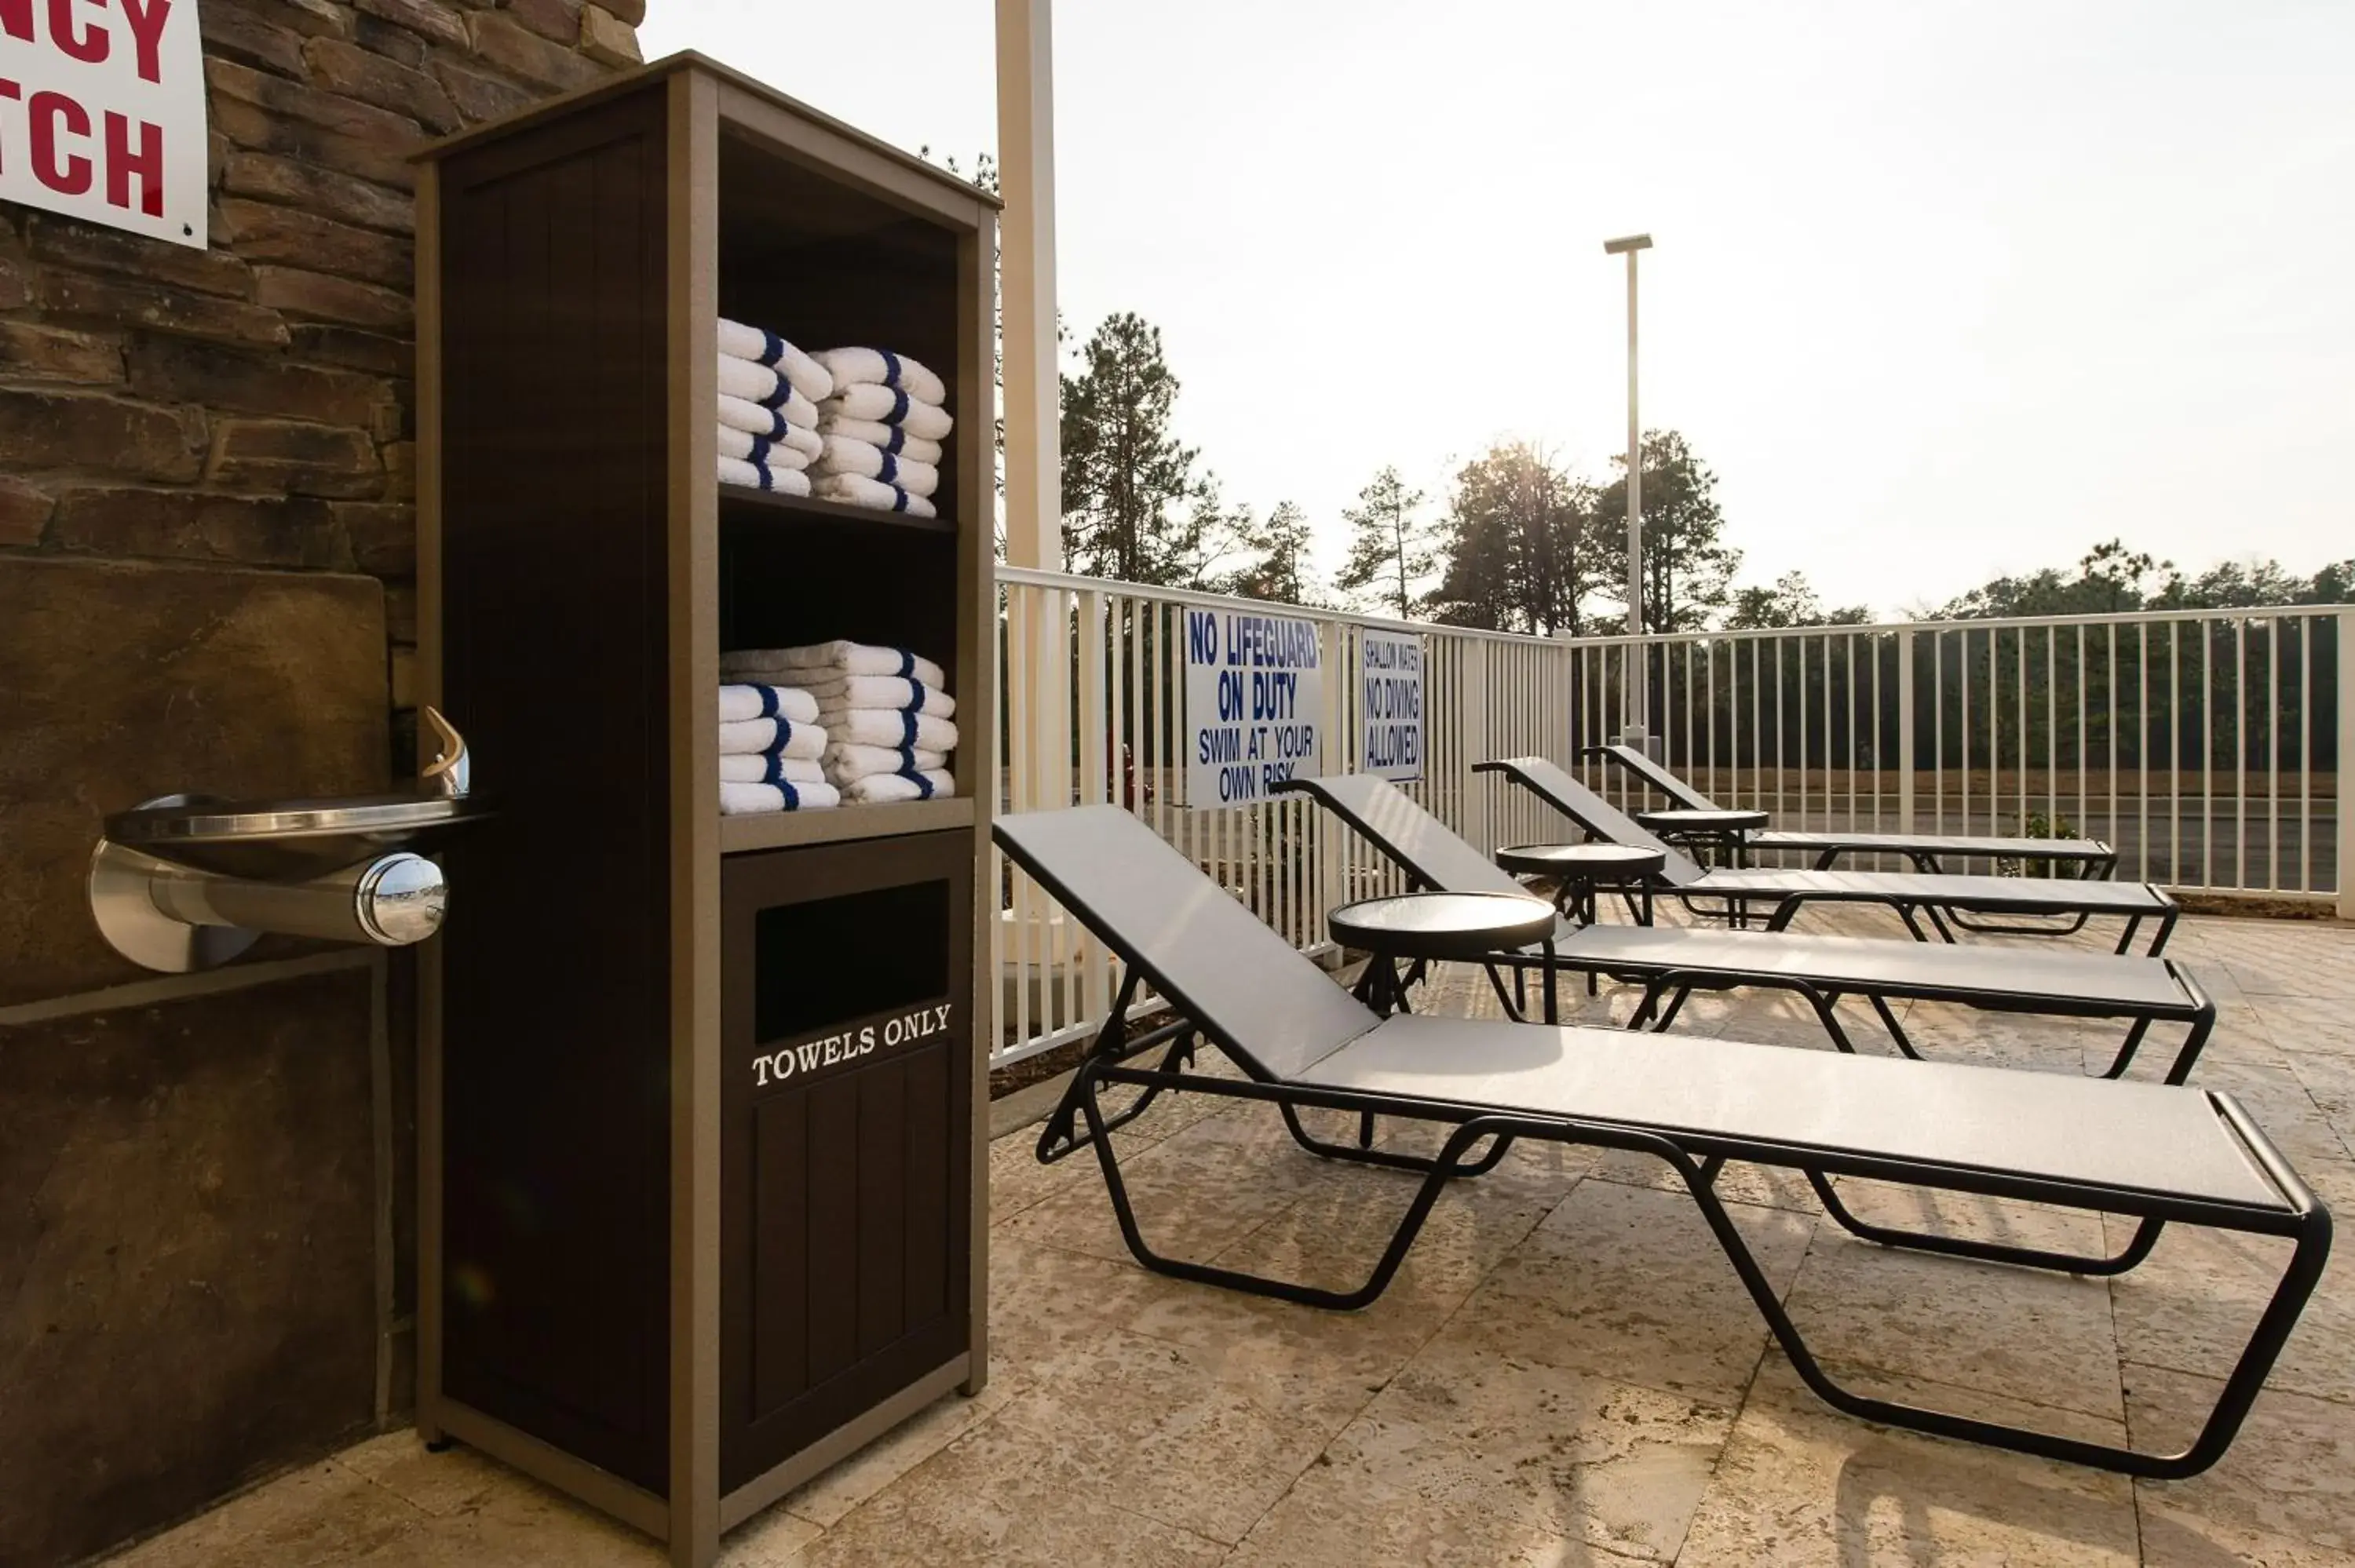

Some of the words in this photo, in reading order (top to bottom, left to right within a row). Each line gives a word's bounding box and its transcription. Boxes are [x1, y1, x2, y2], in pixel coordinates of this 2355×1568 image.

[1189, 611, 1218, 666] NO
[1227, 614, 1317, 669] LIFEGUARD
[1365, 640, 1397, 669] SHALLOW
[1218, 669, 1243, 722] ON
[1253, 671, 1297, 720] DUTY
[1366, 677, 1382, 720] NO
[1386, 677, 1418, 720] DIVING
[1199, 727, 1241, 765] SWIM
[1247, 727, 1268, 760] AT
[1275, 725, 1313, 759] YOUR
[1367, 724, 1418, 768] ALLOWED
[1219, 766, 1256, 802] OWN
[751, 1026, 875, 1086] TOWELS
[884, 1004, 951, 1046] ONLY
